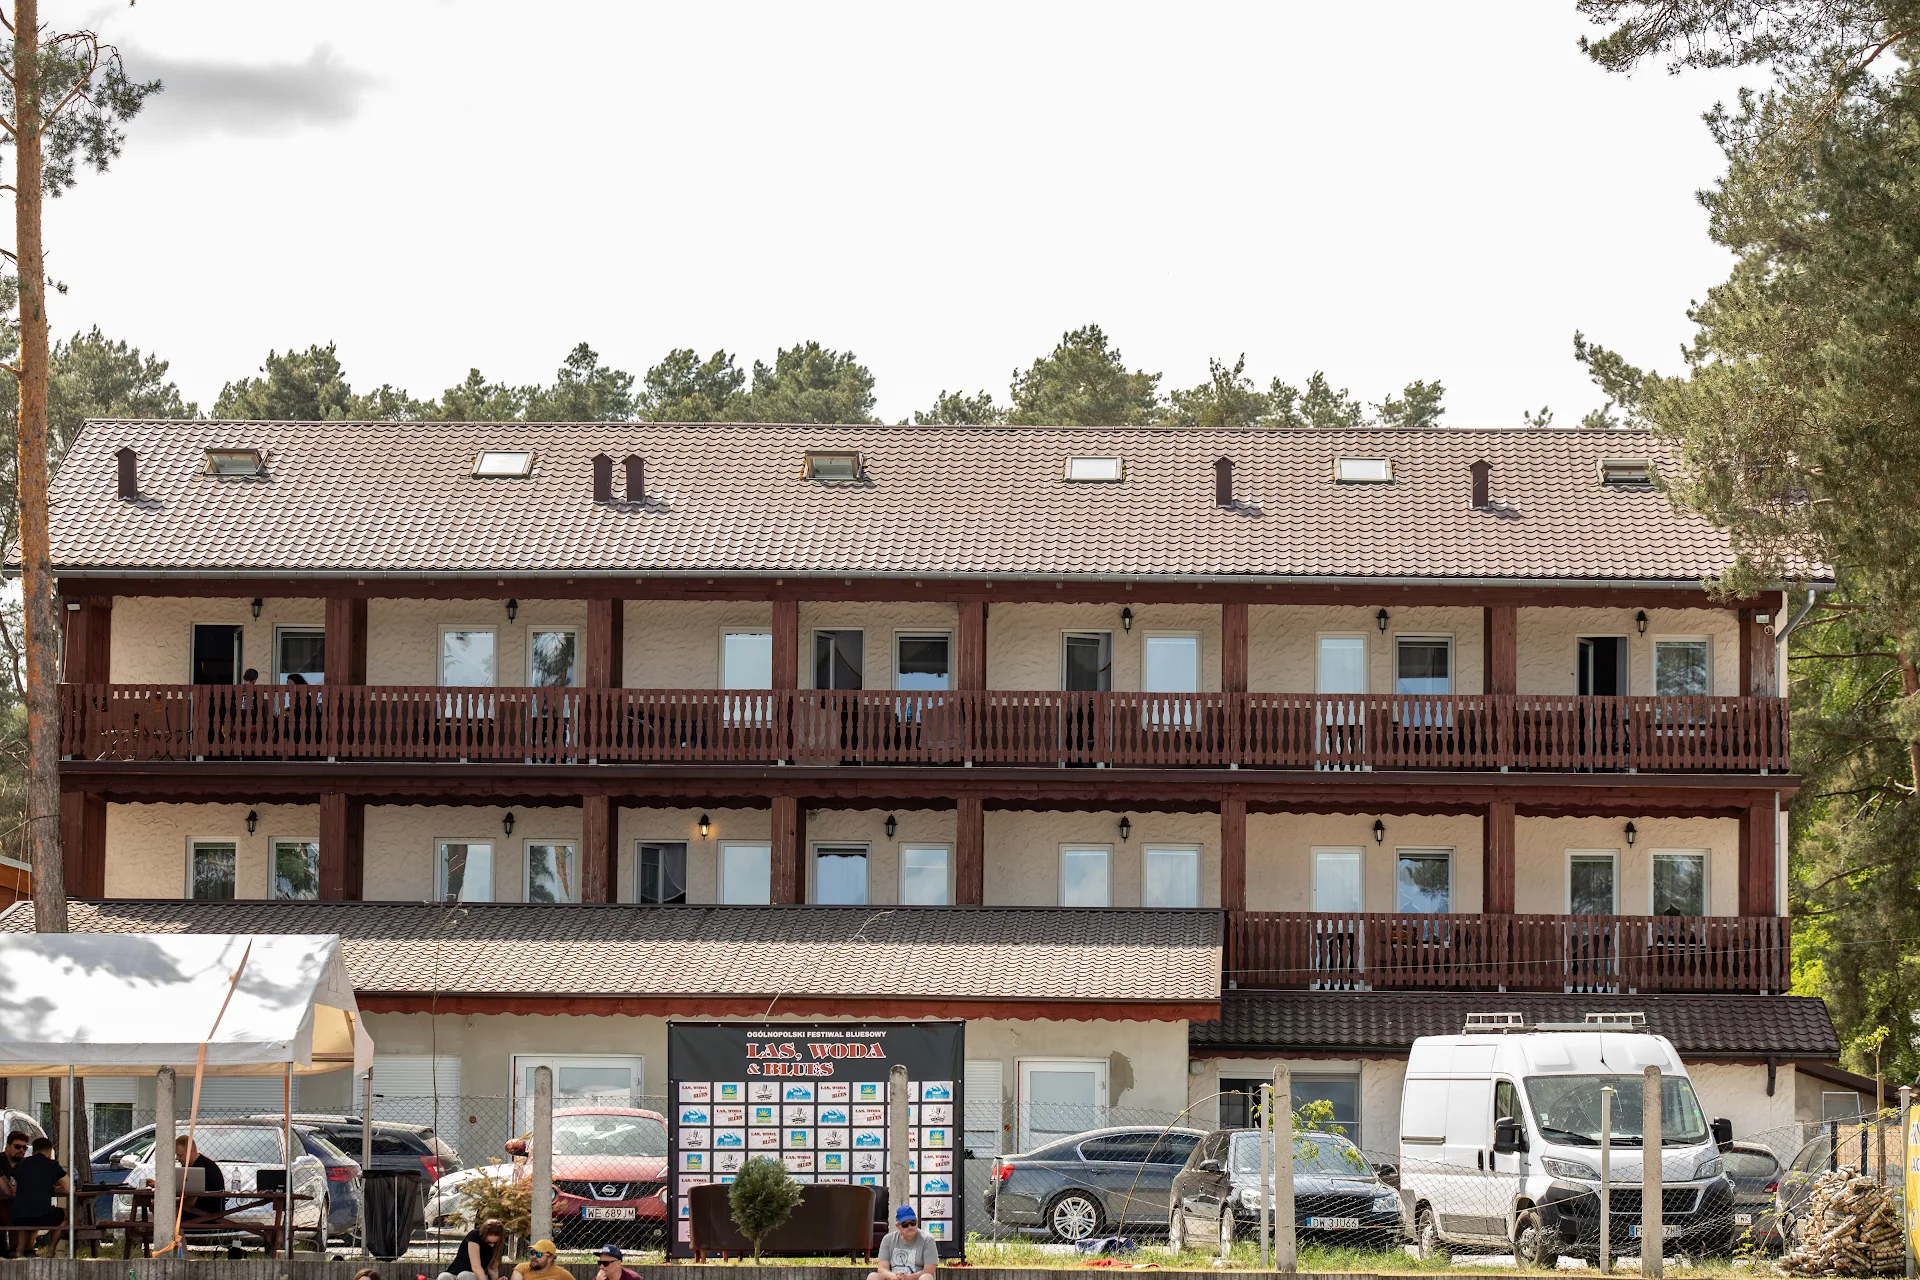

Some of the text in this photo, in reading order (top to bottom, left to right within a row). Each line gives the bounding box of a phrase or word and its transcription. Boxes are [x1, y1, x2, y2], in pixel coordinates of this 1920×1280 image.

[747, 1030, 805, 1038] OGÓLNOPOLSKI
[746, 1042, 886, 1061] LAS, WODA
[747, 1062, 834, 1077] & BLUES
